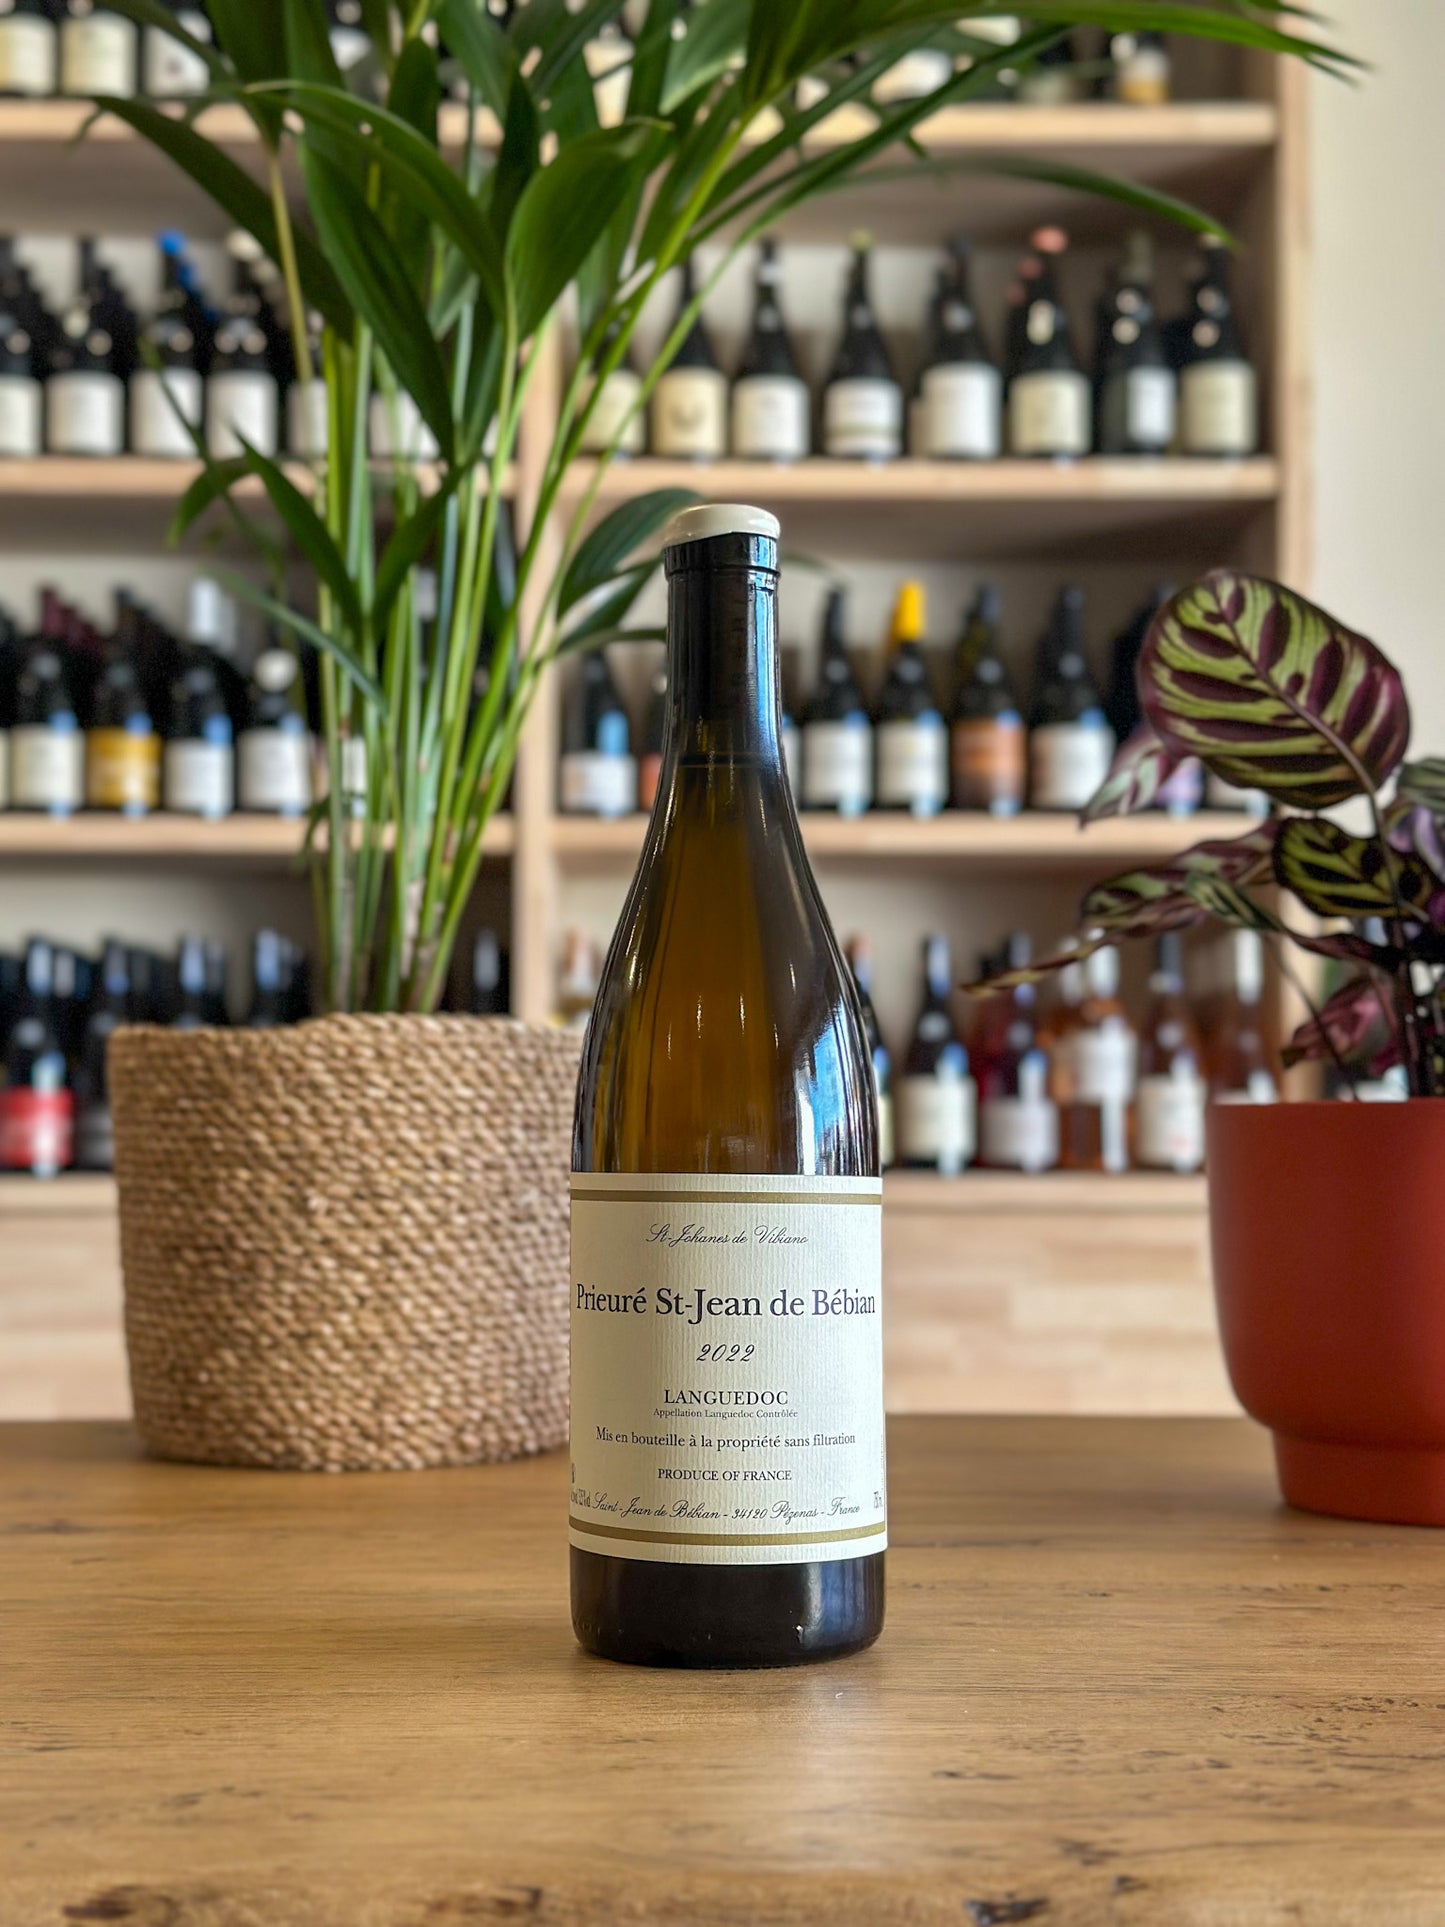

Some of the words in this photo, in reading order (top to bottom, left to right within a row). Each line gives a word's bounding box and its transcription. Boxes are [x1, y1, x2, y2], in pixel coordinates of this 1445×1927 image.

[645, 1223, 730, 1248] St-Johanes
[732, 1230, 748, 1244] de
[753, 1225, 809, 1244] Vibiano
[576, 1283, 648, 1314] Prieuré
[655, 1287, 762, 1325] St-Jean
[769, 1289, 805, 1316] de
[811, 1288, 876, 1316] Bébian
[696, 1343, 755, 1362] 2022
[663, 1389, 789, 1405] LANGUEDOC
[653, 1408, 702, 1419] Appellation
[705, 1409, 754, 1420] Languedoc
[756, 1408, 799, 1418] Contrôlée
[596, 1426, 613, 1441] Mis
[615, 1431, 628, 1443] en
[631, 1431, 686, 1446] bouteille
[689, 1434, 697, 1447] à
[701, 1435, 712, 1447] la
[717, 1435, 781, 1452] propriété
[784, 1436, 810, 1447] sans
[812, 1432, 856, 1446] filtration
[657, 1468, 719, 1480] PRODUCE
[722, 1470, 740, 1481] OF
[743, 1470, 792, 1481] FRANCE
[653, 1504, 667, 1517] de
[669, 1499, 720, 1519] Bébian
[731, 1508, 768, 1519] 34120
[770, 1500, 819, 1526] Pézenas
[826, 1496, 861, 1516] France
